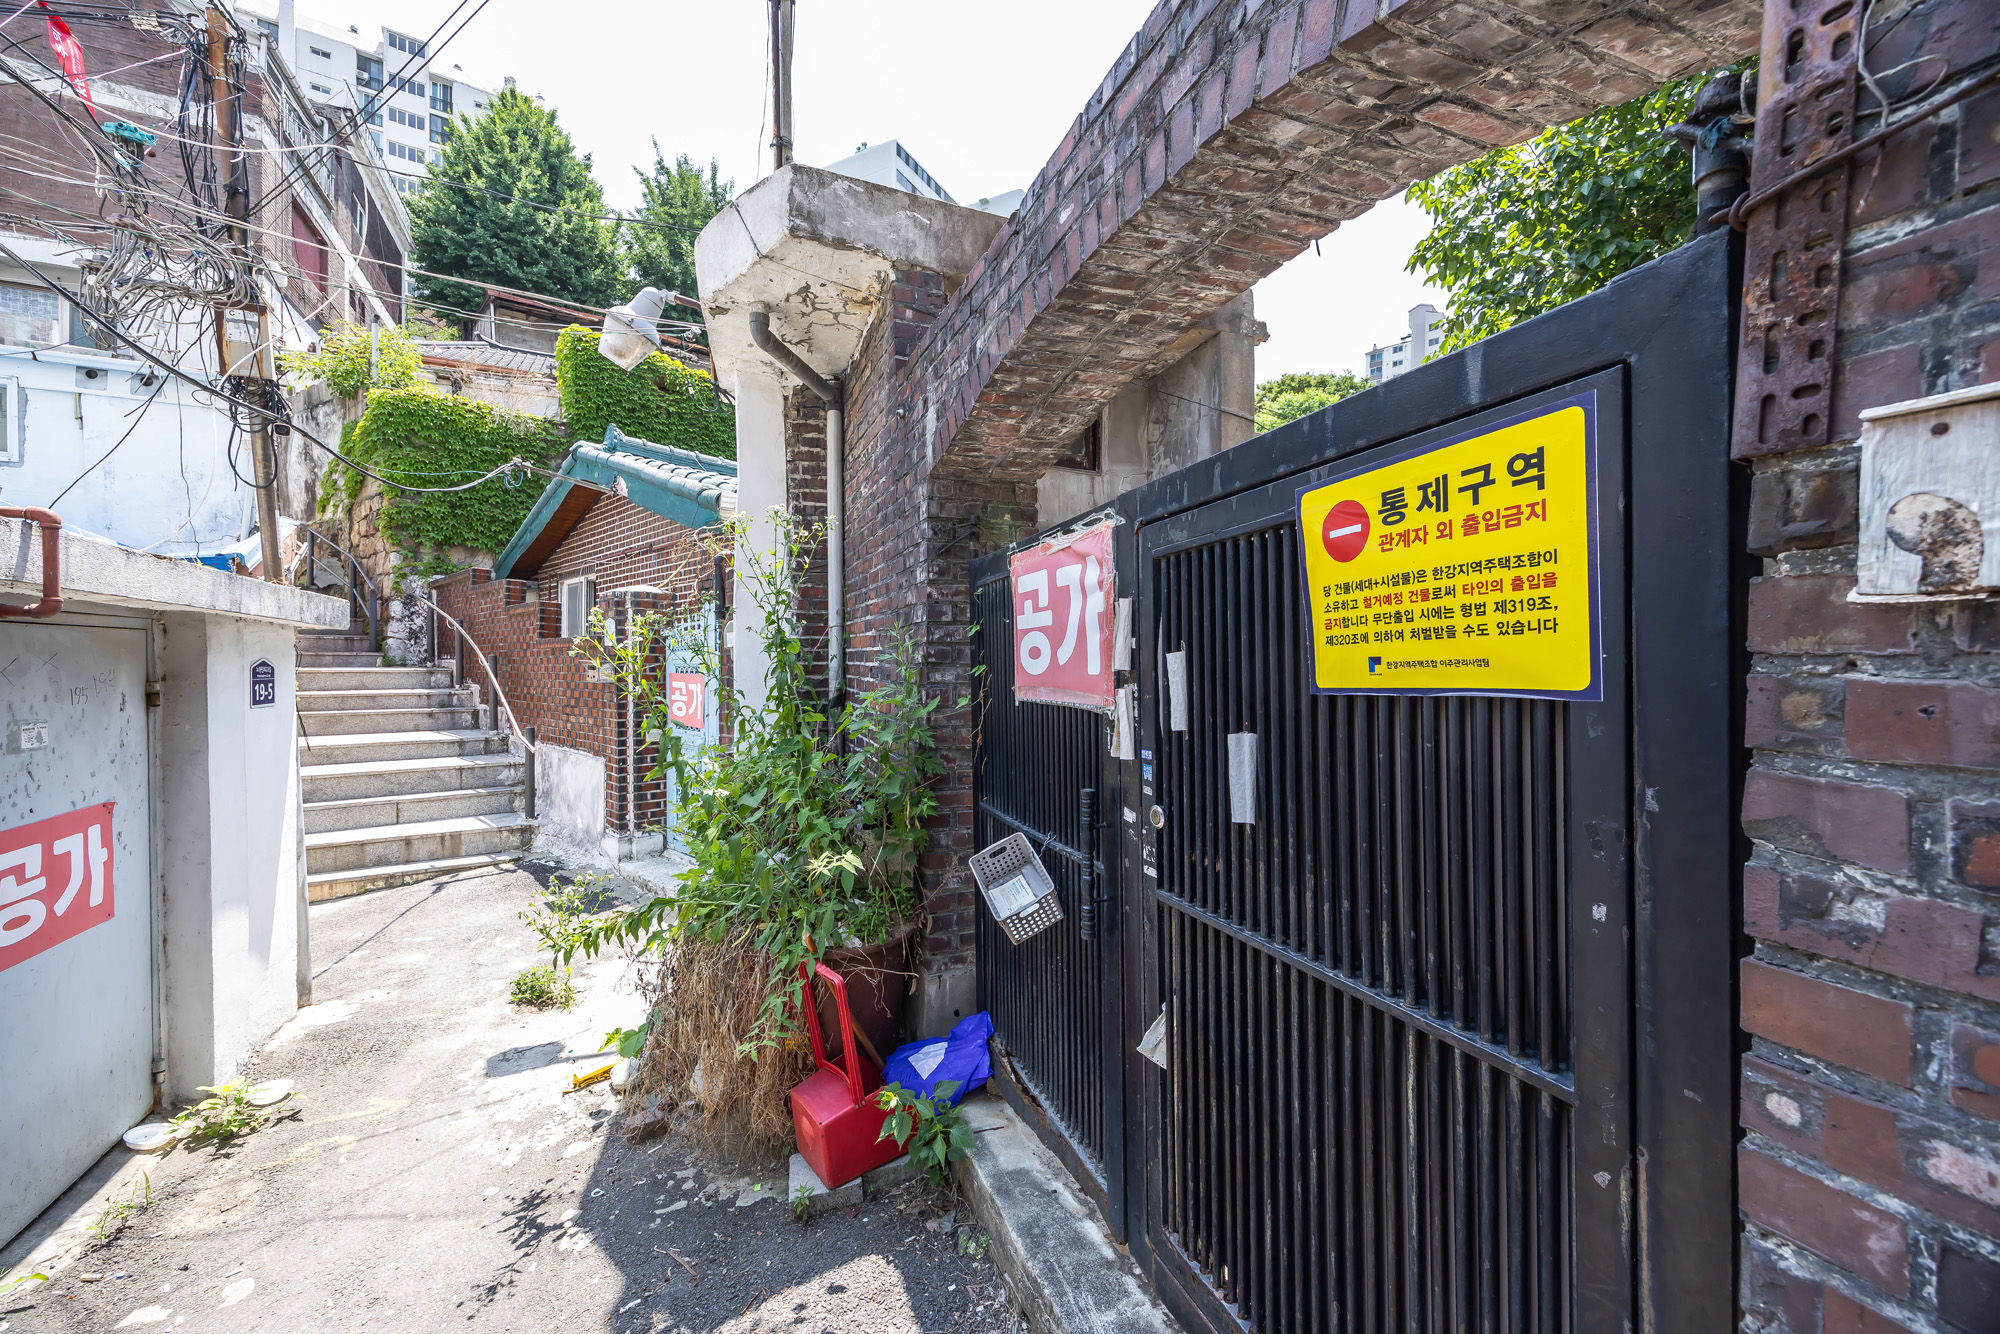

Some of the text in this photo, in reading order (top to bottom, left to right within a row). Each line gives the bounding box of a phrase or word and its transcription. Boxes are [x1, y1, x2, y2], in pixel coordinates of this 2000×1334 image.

[1377, 445, 1546, 527] 통제구역
[1378, 498, 1547, 553] 관계자 외 출입금지
[1322, 548, 1558, 598] 당 건물(세대+시설물)은 한강지역주택조합이
[1323, 571, 1558, 614] 소유하고 철거예정 건물로써 타인의 출입을
[1016, 554, 1105, 676] 공가
[1324, 595, 1558, 631] 금지합니다 무단출입 시에는 형법 제319조,
[1324, 616, 1559, 647] 제320조에 의하여 처벌받을 수도 있습니다
[1386, 658, 1490, 670] 한강지역주택조합 이주관리사업팀
[69, 686, 89, 706] 195
[254, 682, 273, 701] 19-5
[671, 680, 703, 720] 공가
[0, 823, 109, 948] 공가
